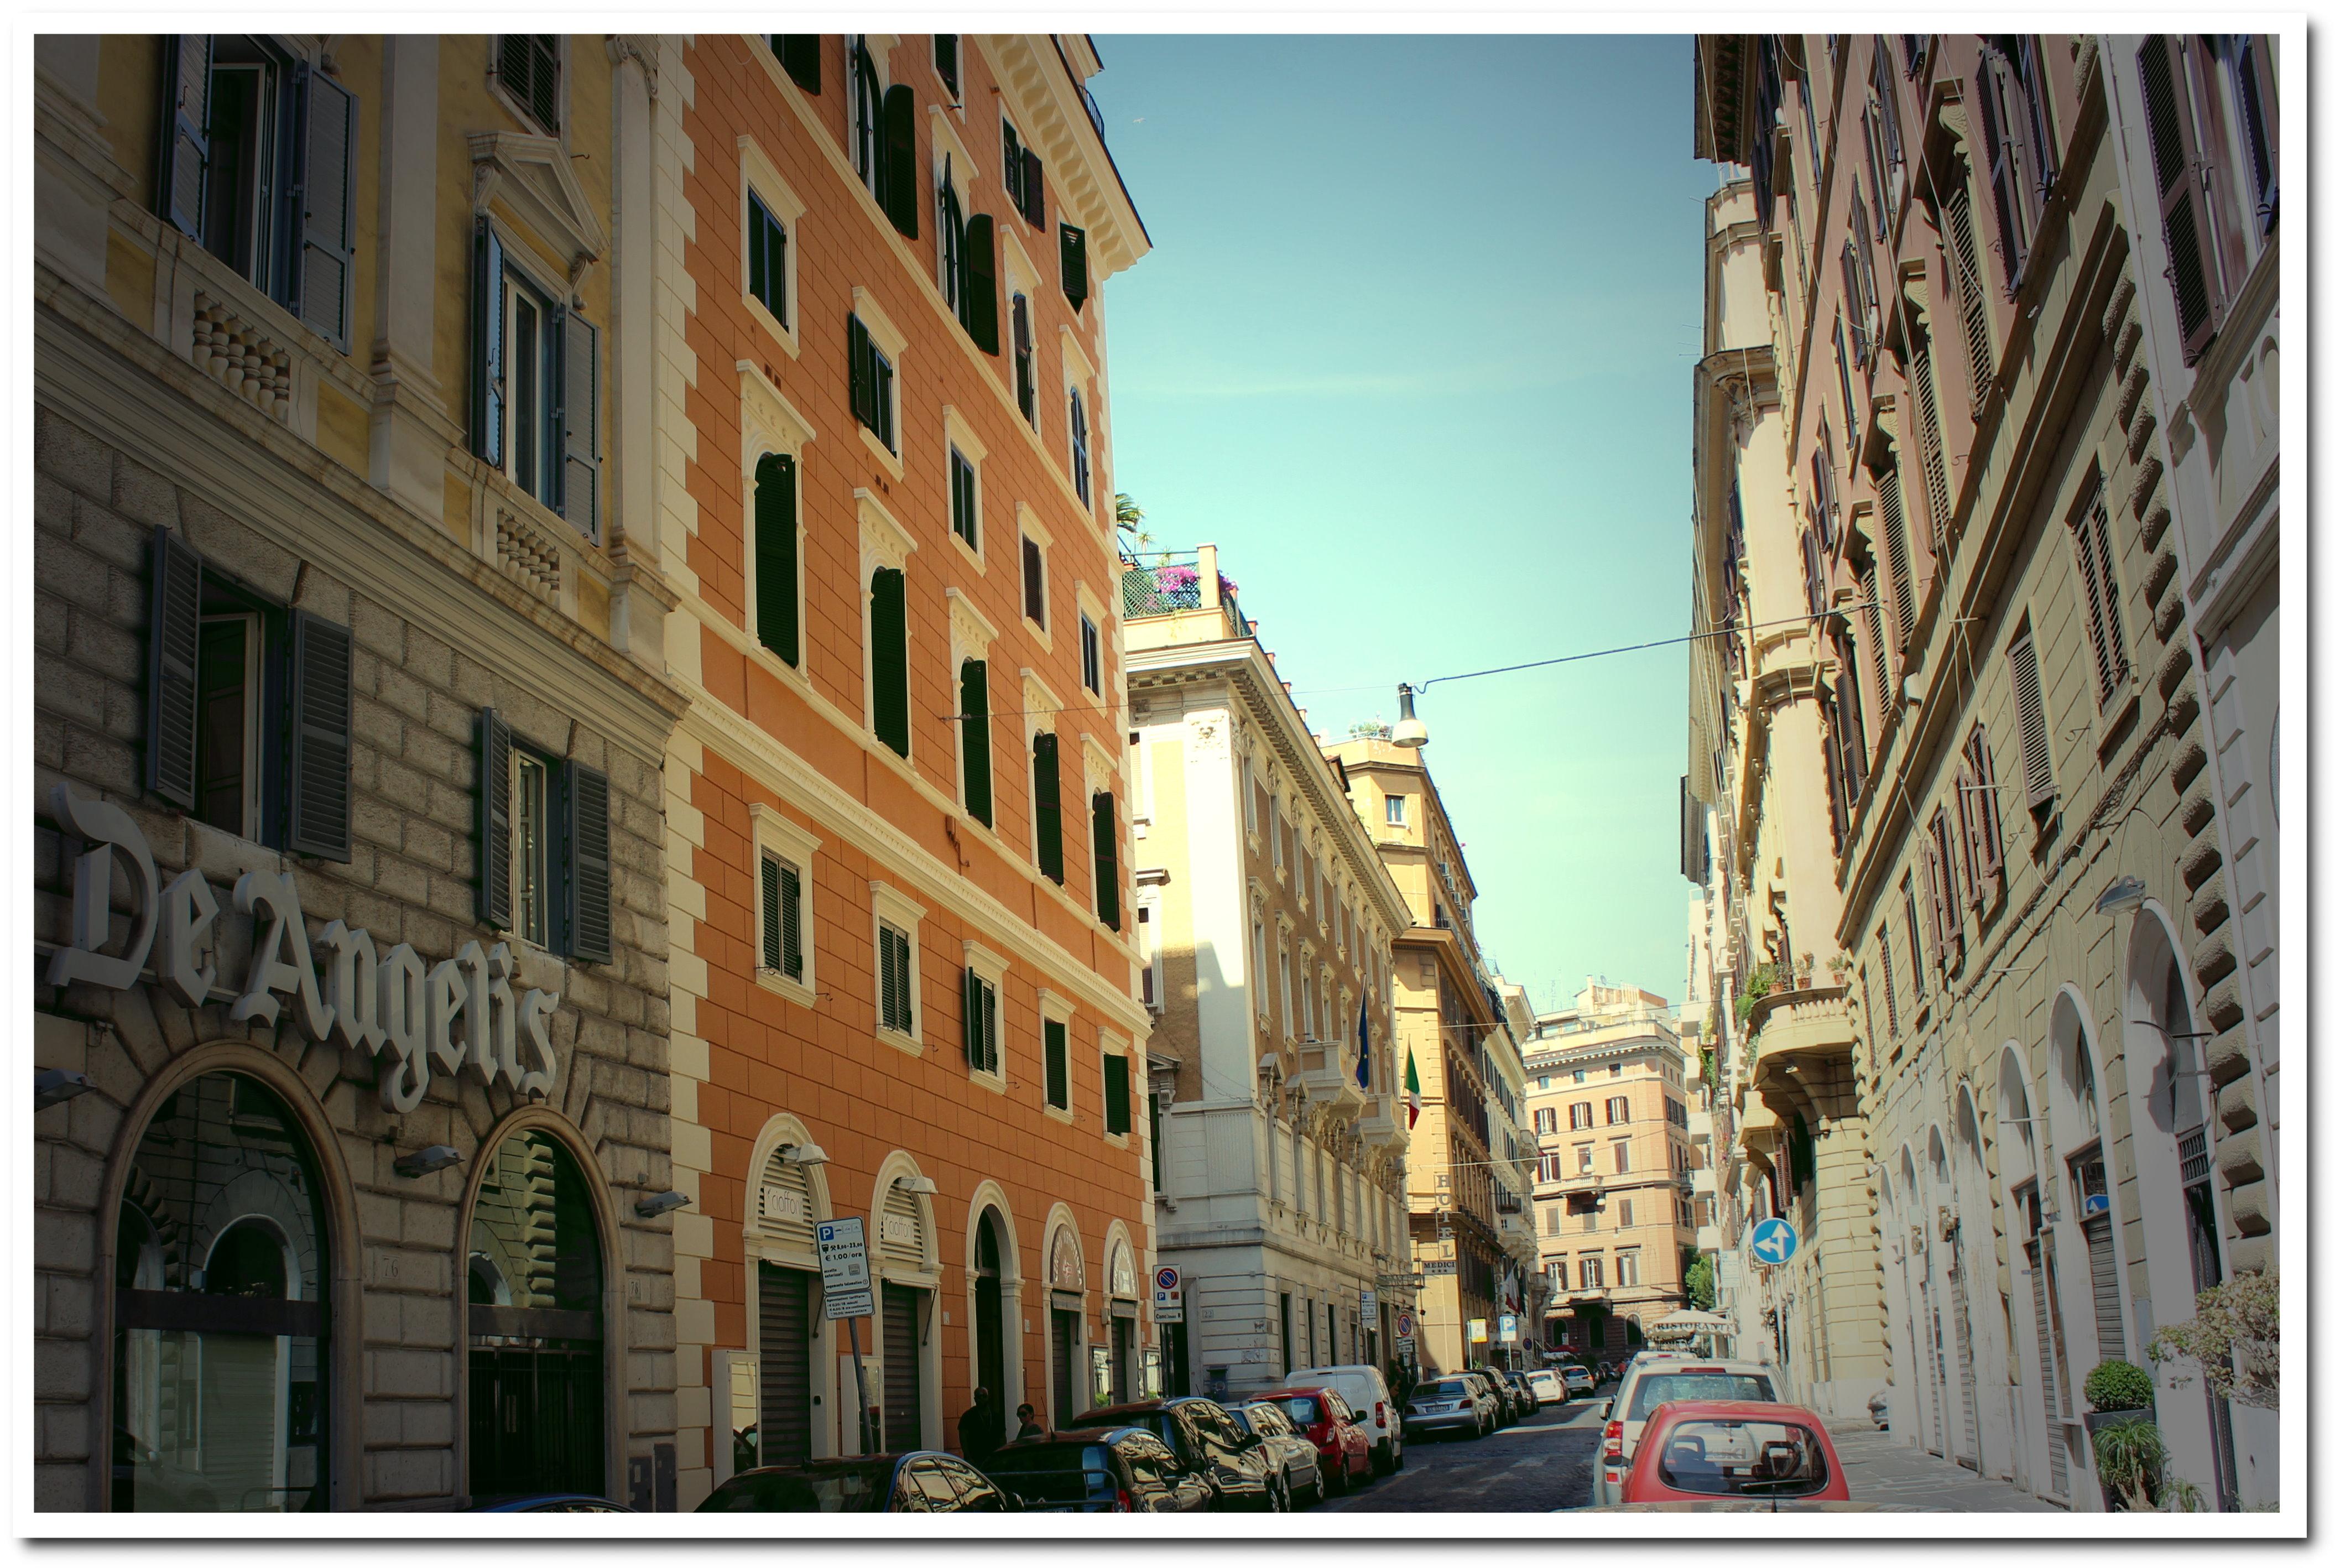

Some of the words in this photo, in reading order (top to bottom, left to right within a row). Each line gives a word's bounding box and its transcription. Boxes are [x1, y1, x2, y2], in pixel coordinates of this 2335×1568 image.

[46, 782, 220, 1008] De
[229, 869, 559, 1113] Angelis
[1437, 1174, 1455, 1258] HOTEL
[822, 1228, 831, 1239] P
[383, 1257, 398, 1278] 76
[630, 1280, 639, 1298] 78
[1503, 1317, 1513, 1331] P
[1657, 1322, 1733, 1332] RISTORANTE
